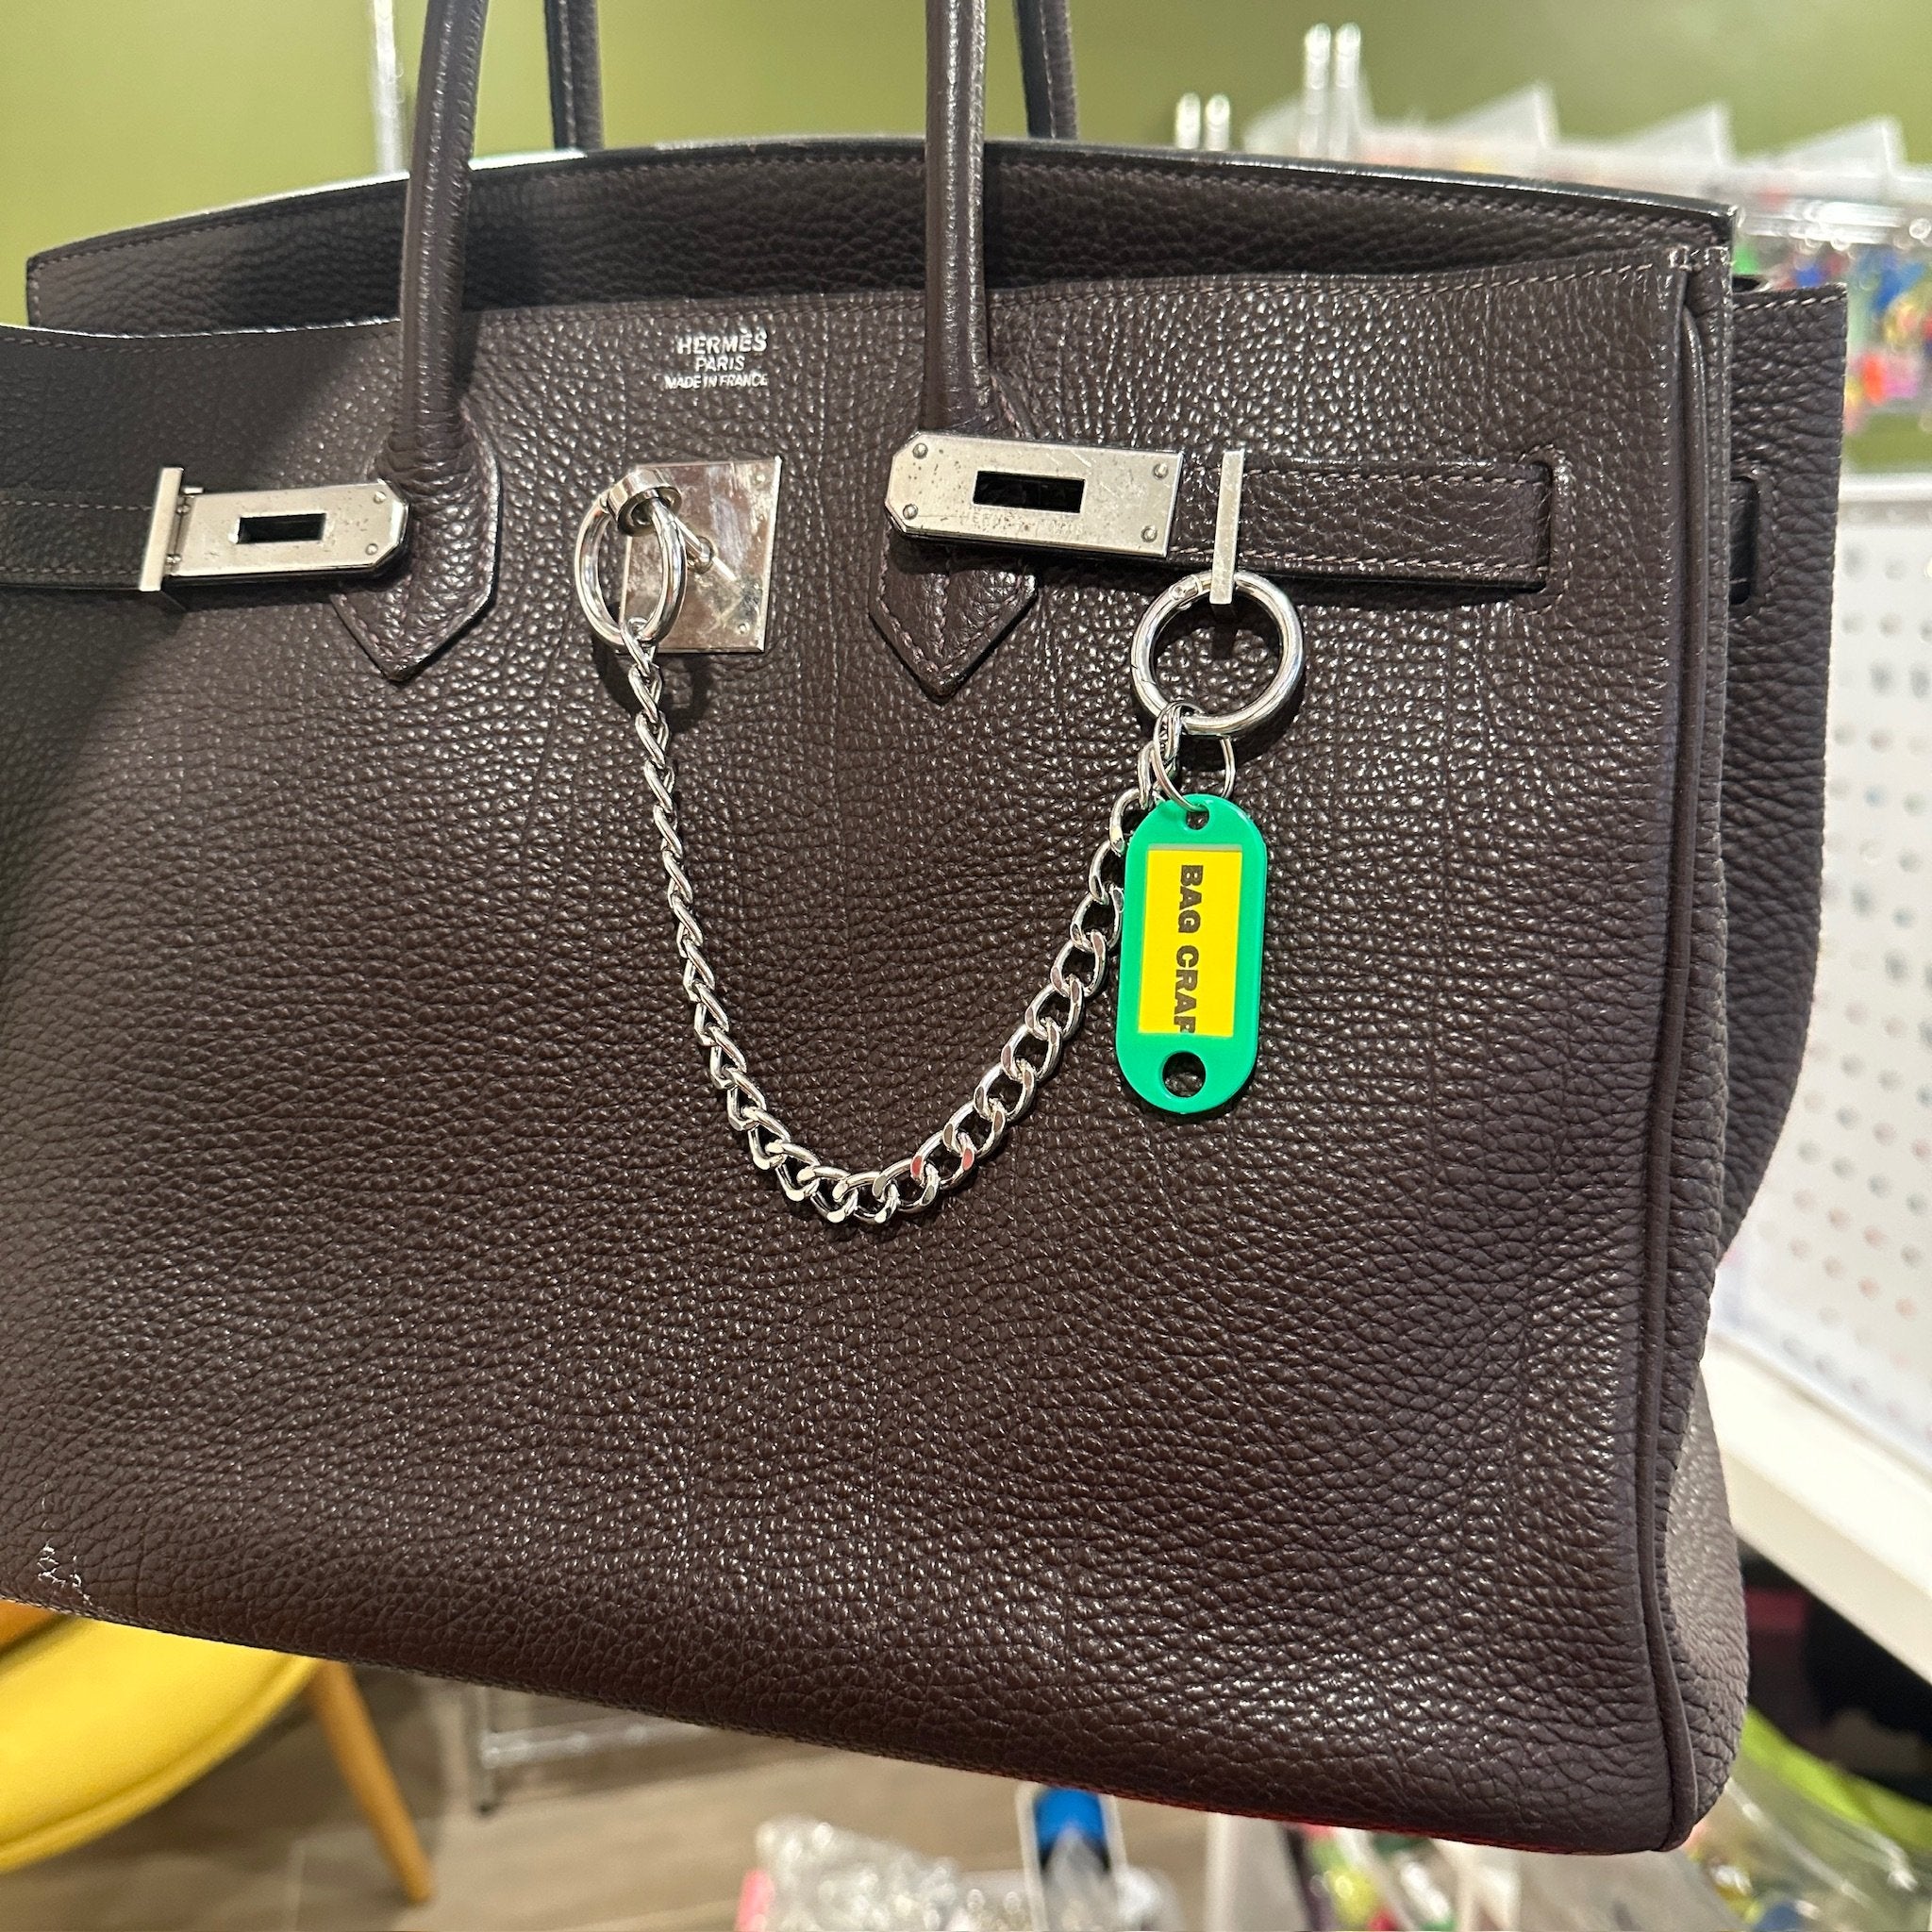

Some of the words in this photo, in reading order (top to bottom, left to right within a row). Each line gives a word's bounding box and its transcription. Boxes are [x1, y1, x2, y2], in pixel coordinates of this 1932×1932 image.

[694, 355, 746, 372] PARIS
[664, 375, 701, 390] MADE
[703, 375, 718, 388] IN
[719, 372, 769, 387] FRANCE
[1177, 864, 1204, 933] BAG
